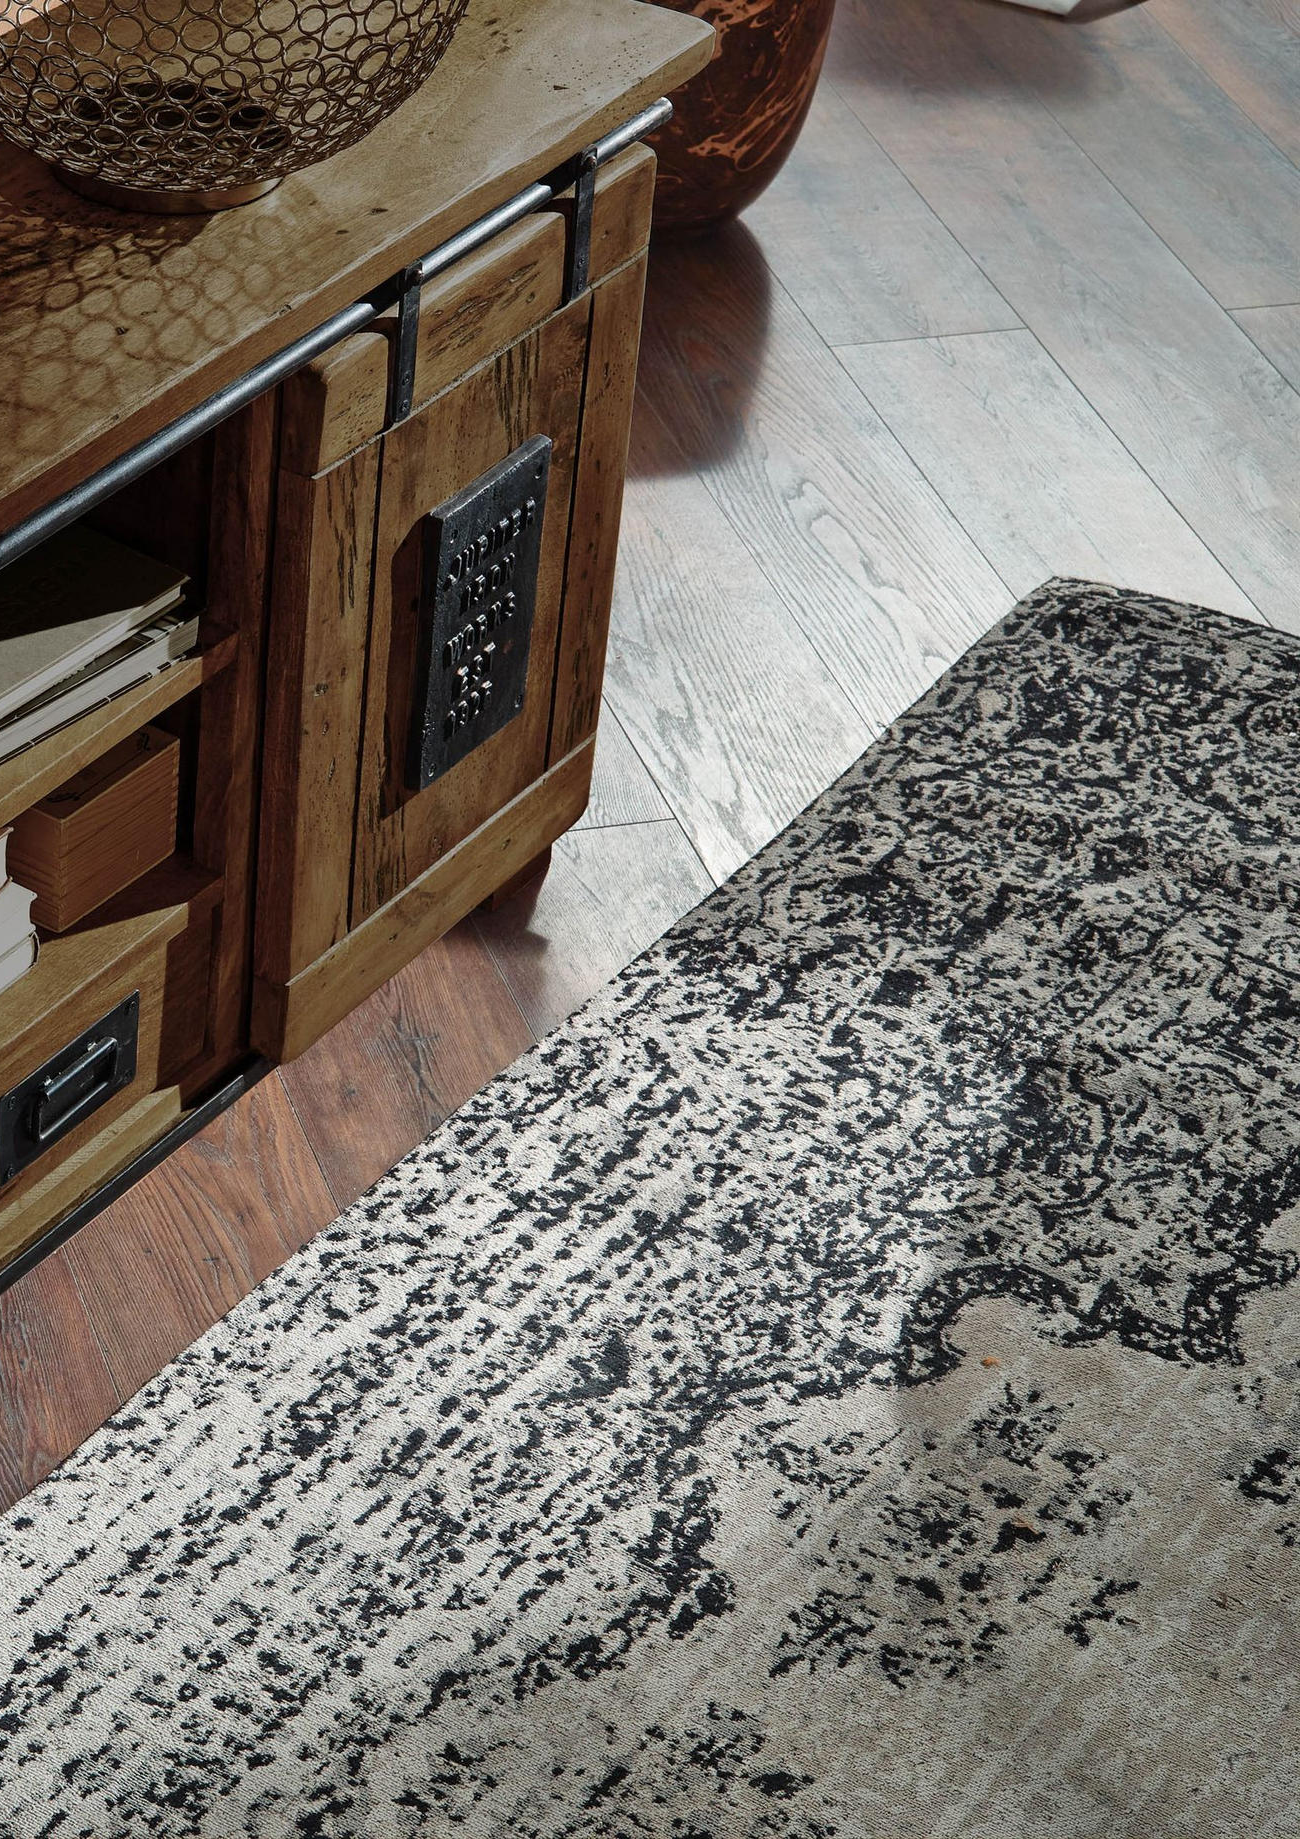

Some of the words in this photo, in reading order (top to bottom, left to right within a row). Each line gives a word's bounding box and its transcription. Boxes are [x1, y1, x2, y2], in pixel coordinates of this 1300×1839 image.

[447, 497, 536, 584] JUPITER
[465, 552, 516, 608] IRON
[447, 591, 516, 664] WORKS
